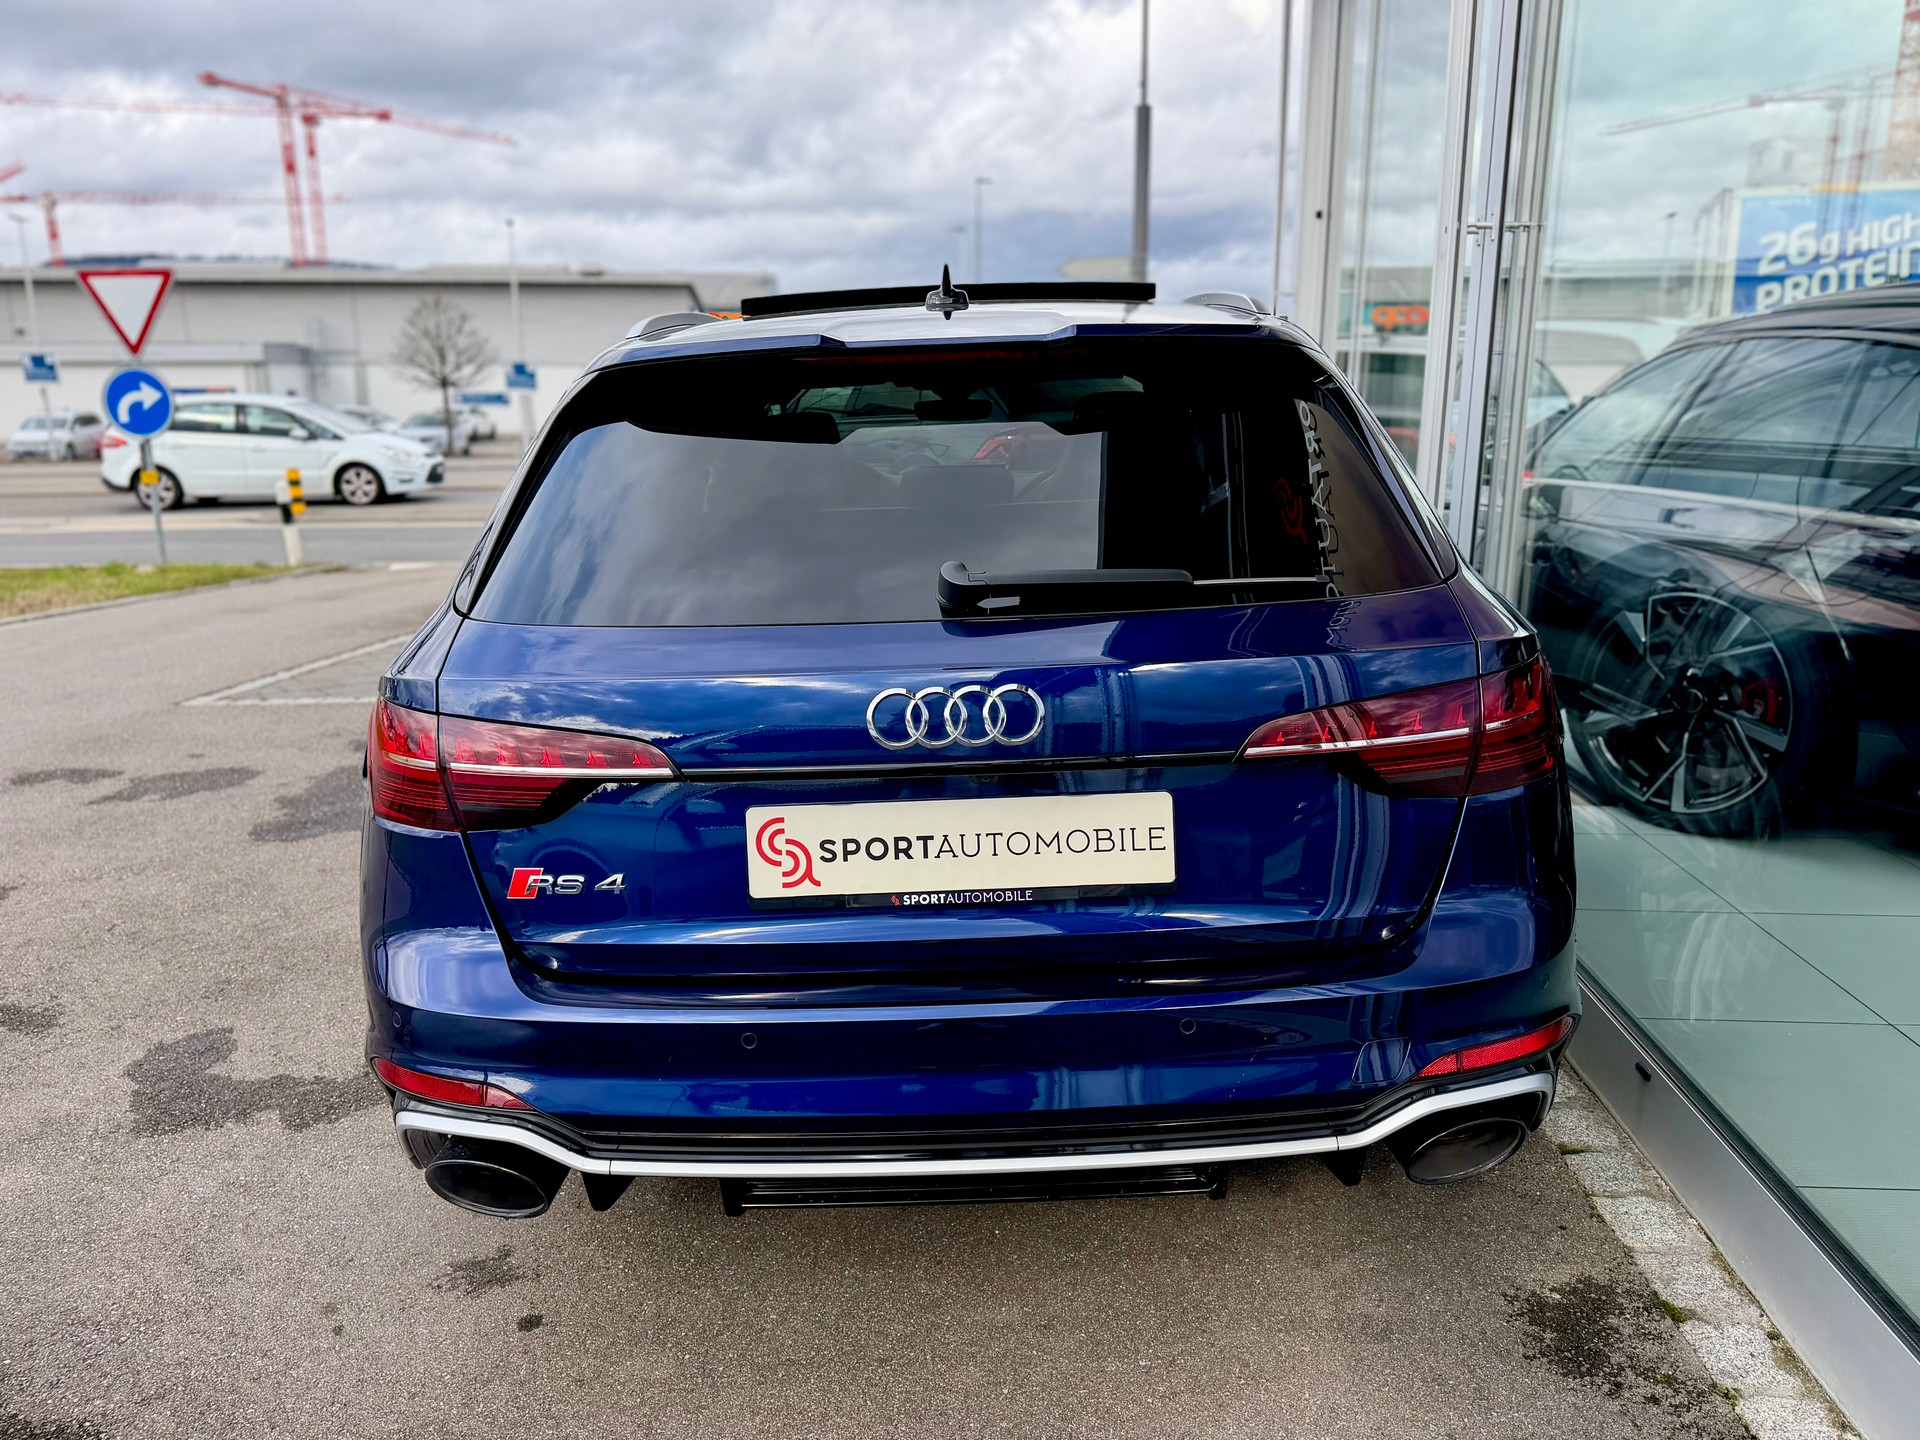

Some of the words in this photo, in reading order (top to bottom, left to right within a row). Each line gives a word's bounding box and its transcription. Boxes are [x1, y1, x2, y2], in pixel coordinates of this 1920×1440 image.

[1757, 221, 1841, 276] 26g
[819, 826, 1167, 863] SPORTAUTOMOBILE
[524, 874, 585, 895] RS
[594, 873, 628, 894] 4
[902, 889, 1033, 906] SPORTAUTOMOBILE
